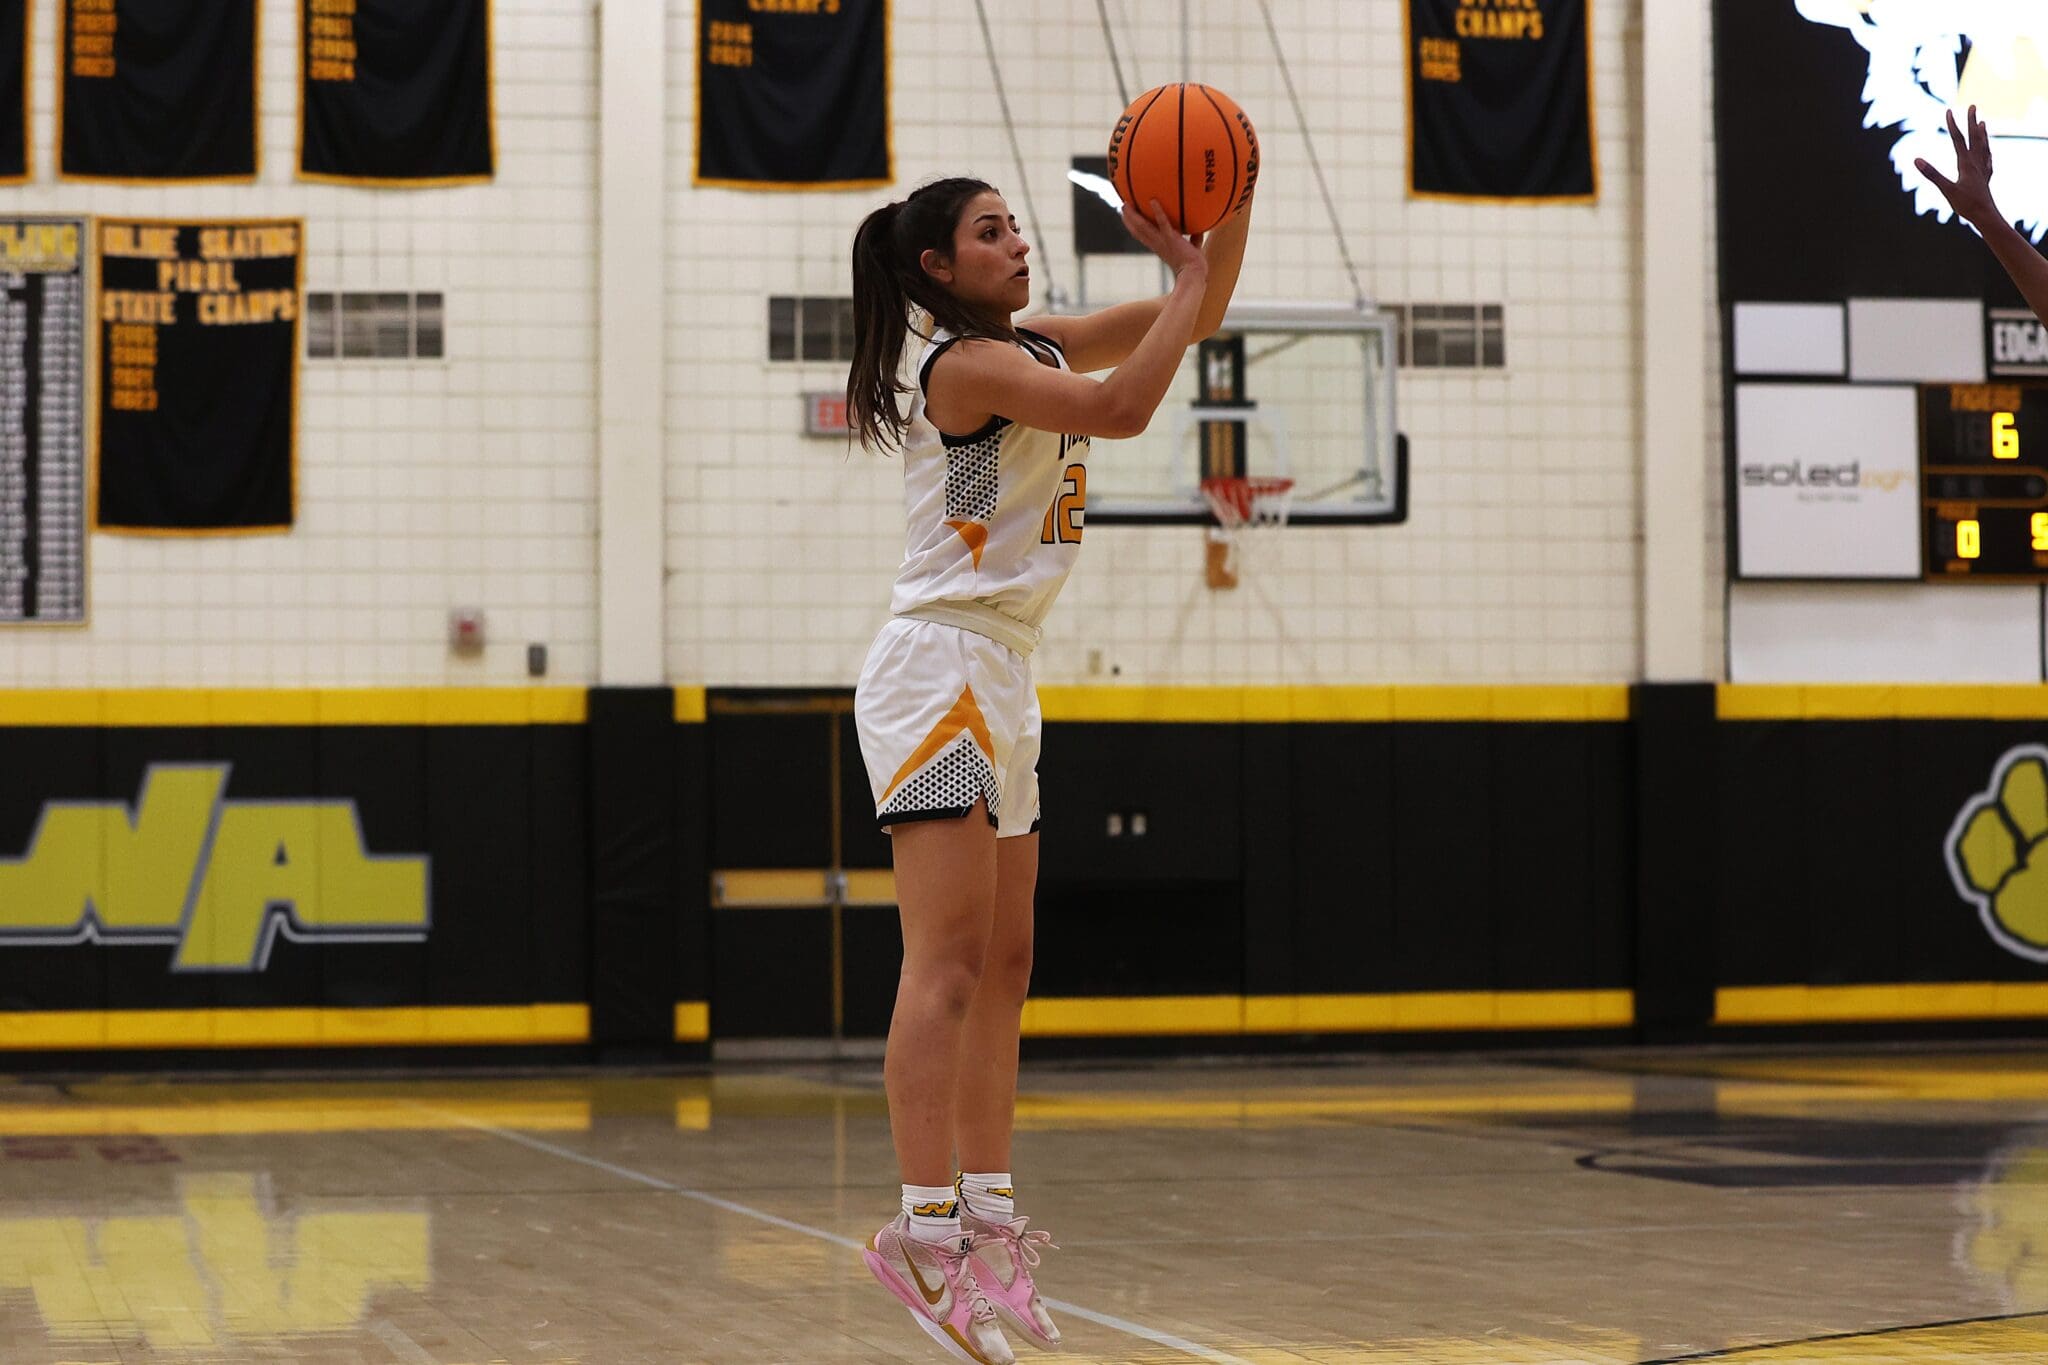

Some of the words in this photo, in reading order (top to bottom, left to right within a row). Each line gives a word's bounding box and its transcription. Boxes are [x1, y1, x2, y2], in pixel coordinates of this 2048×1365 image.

[1455, 9, 1543, 39] CHAMPS
[1205, 149, 1216, 184] NFHS
[103, 290, 177, 325] STATE
[198, 289, 296, 325] CHAMPS
[1992, 412, 2019, 459] 6
[1041, 463, 1087, 545] 12
[1957, 520, 1980, 559] 0
